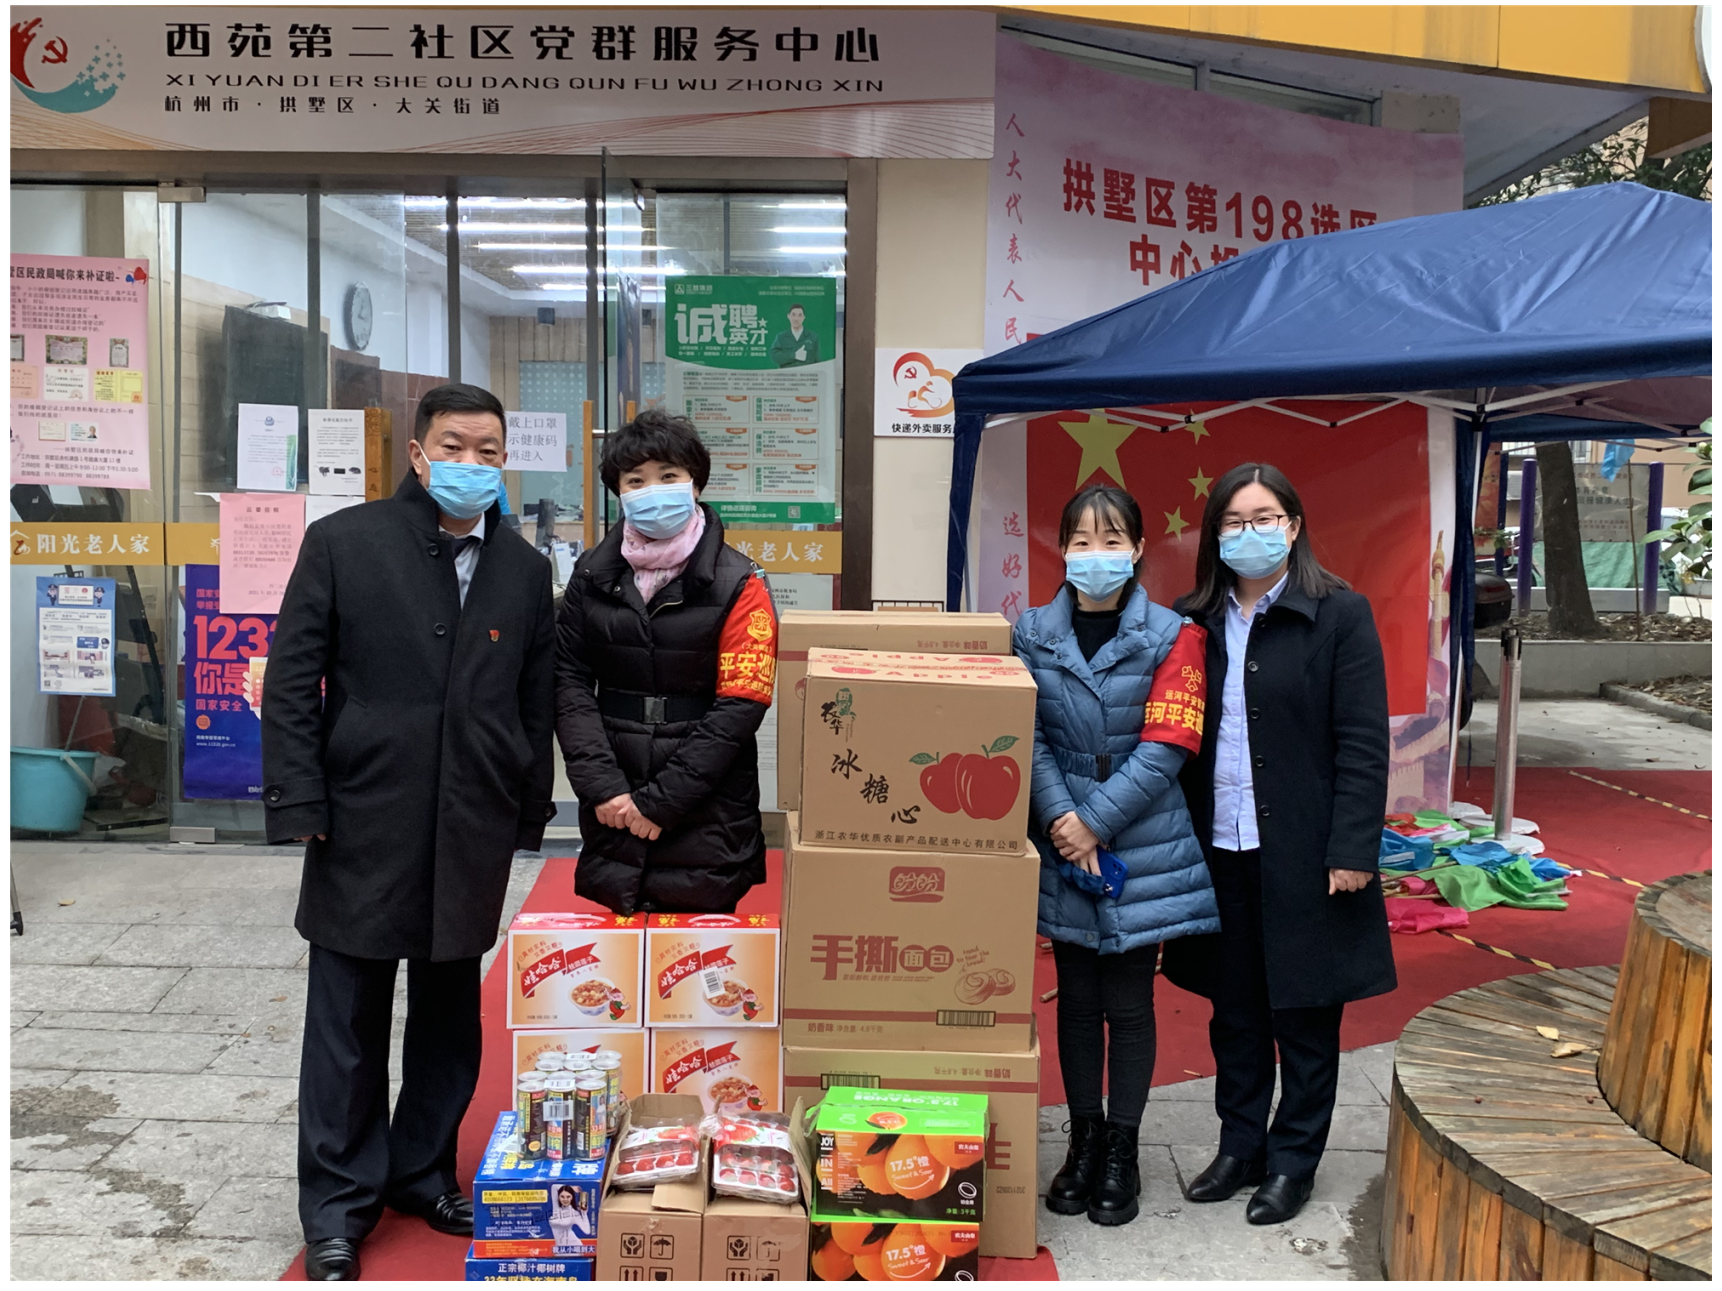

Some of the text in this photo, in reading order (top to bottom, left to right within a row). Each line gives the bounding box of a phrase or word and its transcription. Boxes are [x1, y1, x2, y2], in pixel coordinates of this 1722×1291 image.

[165, 23, 880, 62] 西苑第二社区党群服务中心
[166, 74, 883, 92] XI YUAN DI ER SHE QU DANG QUN FU WU ZHONG XIN
[508, 416, 558, 429] 戴上口罩
[892, 423, 955, 434] 快递外卖服务
[508, 433, 558, 447] 示健康码
[509, 449, 543, 462] 再进入
[37, 534, 150, 554] 阳光老人家
[727, 541, 824, 562] 光老人家
[1001, 511, 1025, 617] 选好代
[193, 615, 277, 659] 123
[195, 699, 243, 712] 国家安全
[815, 830, 1019, 850] 浙江农华优质农副产品配送中心有限公司
[808, 1022, 834, 1033] 奶香味
[820, 1136, 834, 1146] JOY
[820, 1158, 833, 1167] IN
[498, 1263, 566, 1273] 正宗椰汁椰树牌
